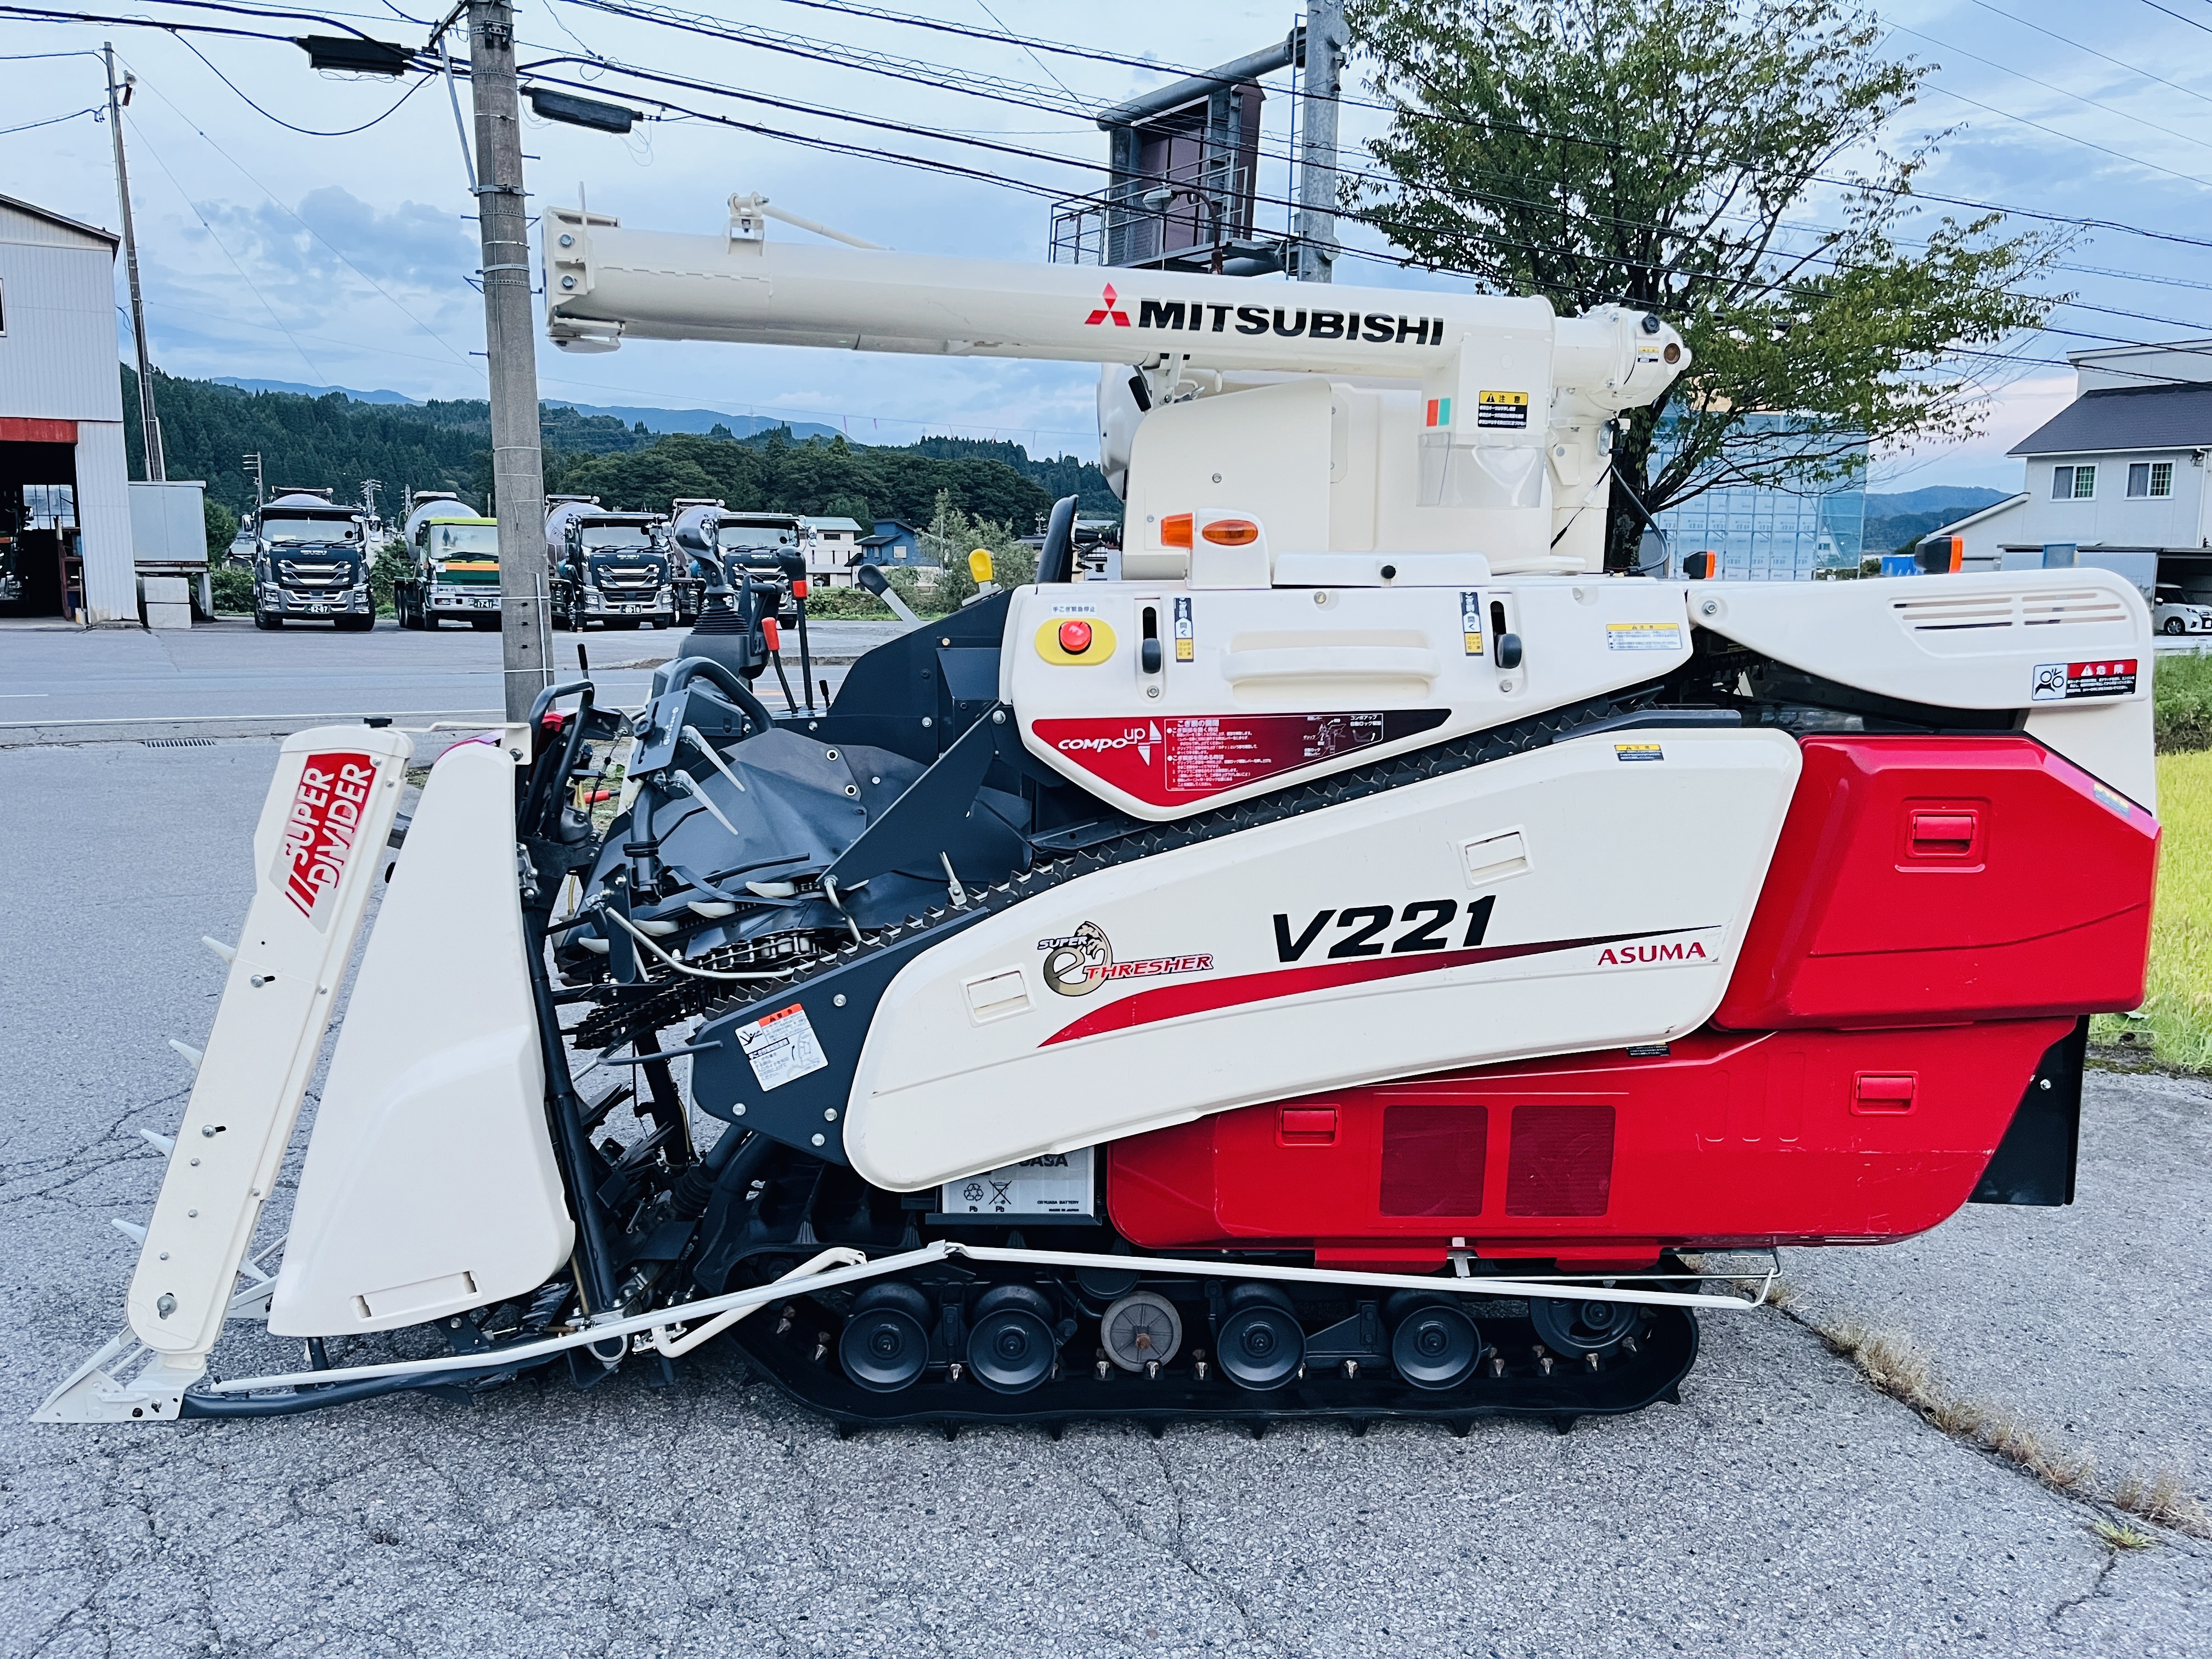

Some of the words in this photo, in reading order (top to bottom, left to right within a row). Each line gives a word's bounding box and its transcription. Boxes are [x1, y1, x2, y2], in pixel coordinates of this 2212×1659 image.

[1139, 297, 1444, 346] MITSUBISHI
[283, 768, 335, 866] SUPER
[307, 763, 373, 889] DIVIDER
[1038, 936, 1088, 949] SUPER
[1273, 895, 1497, 963] V221
[1086, 956, 1211, 979] THRESHER
[1597, 942, 1706, 966] ASUMA
